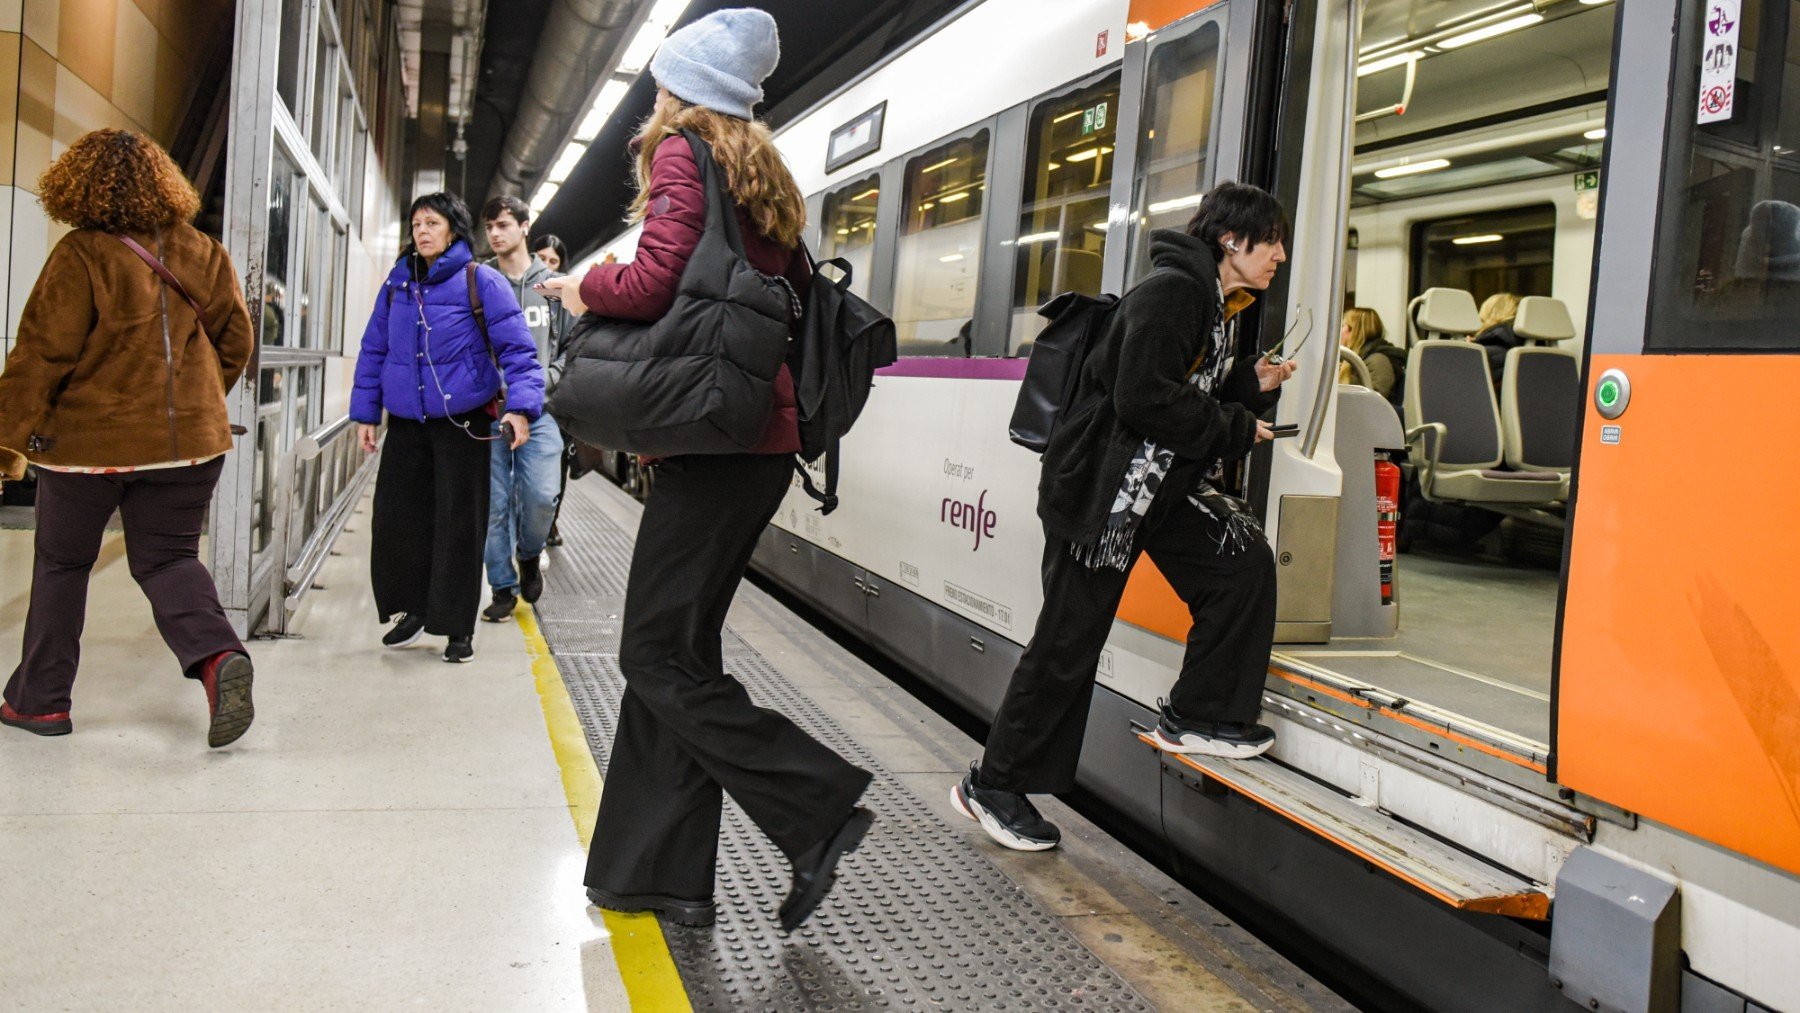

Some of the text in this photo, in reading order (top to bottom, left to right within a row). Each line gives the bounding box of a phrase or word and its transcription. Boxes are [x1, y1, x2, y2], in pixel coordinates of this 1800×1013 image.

[943, 457, 974, 483] Operat per
[941, 489, 996, 552] renfe
[945, 585, 958, 600] FRENO
[958, 591, 995, 617] ESTACIONAMIENTO
